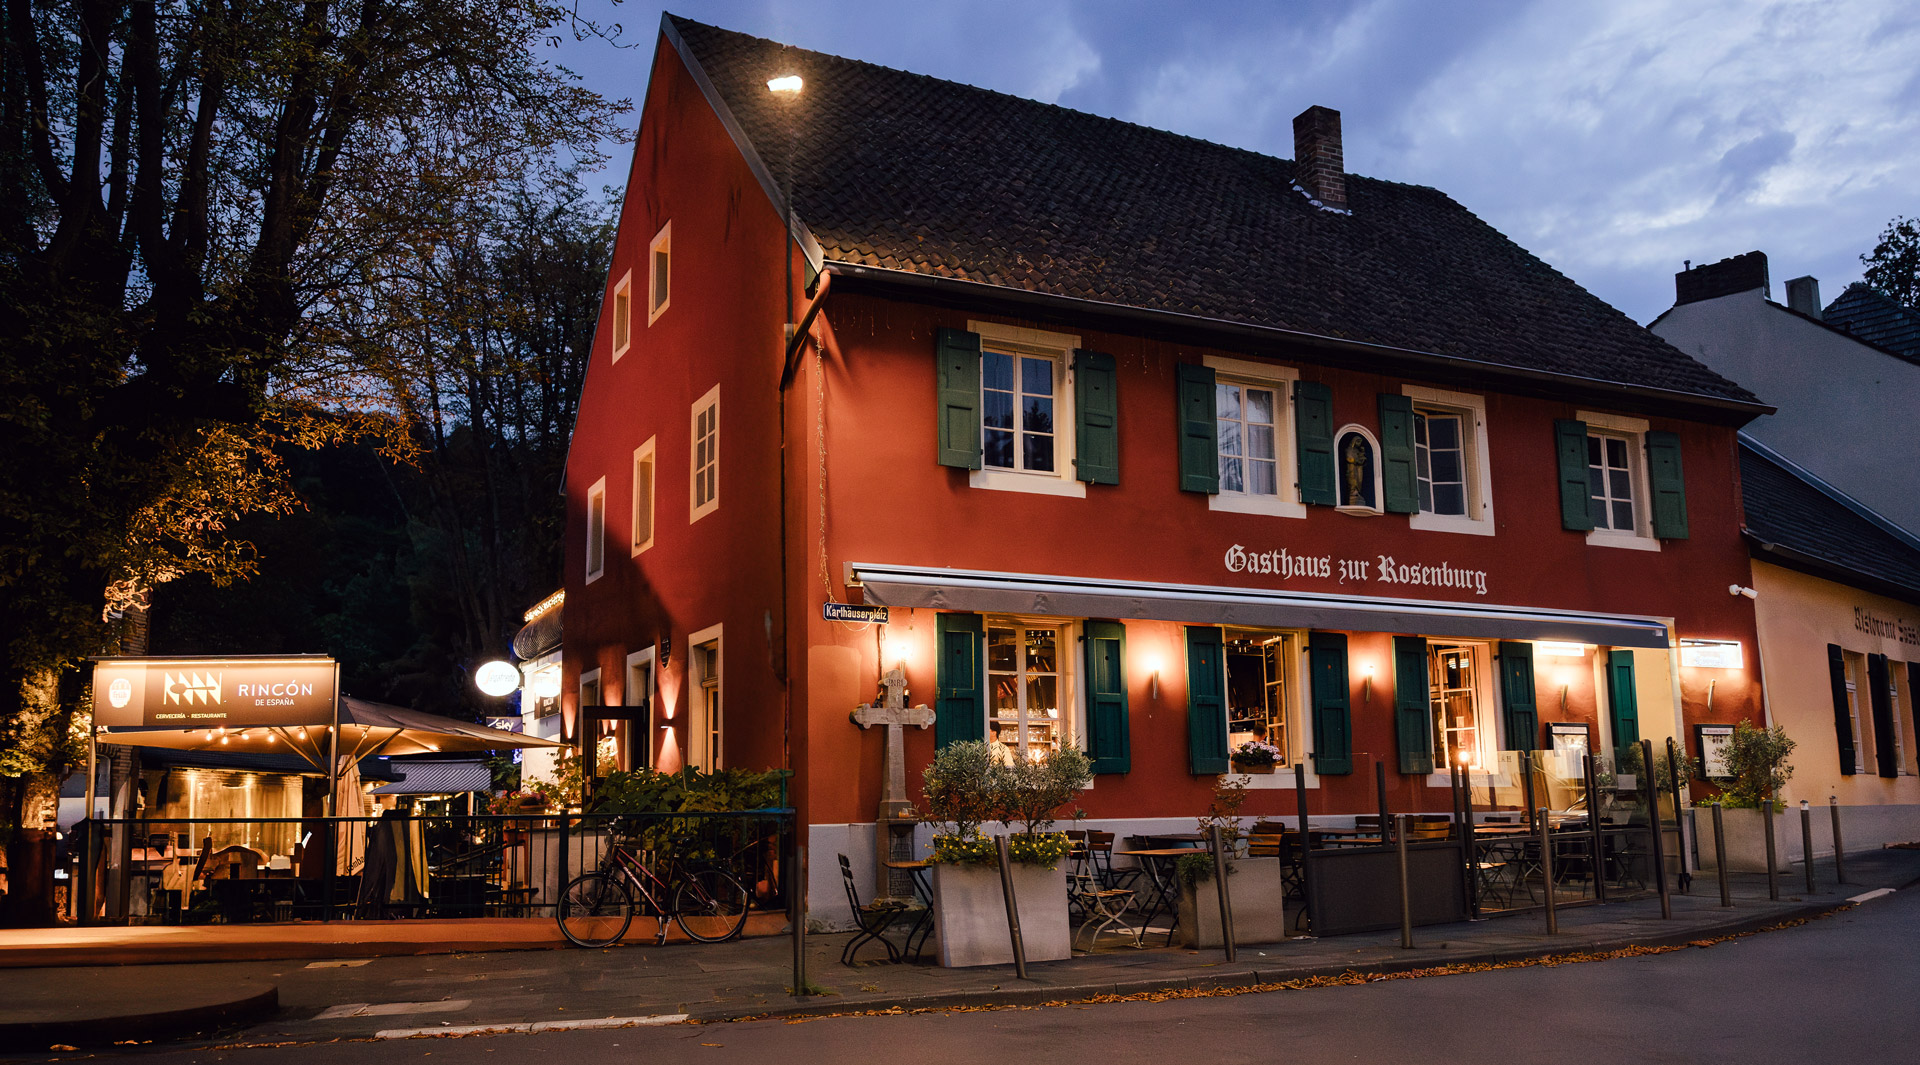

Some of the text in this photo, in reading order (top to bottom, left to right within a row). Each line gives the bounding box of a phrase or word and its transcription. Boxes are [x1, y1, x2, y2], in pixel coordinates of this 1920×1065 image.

[1224, 543, 1488, 596] Gasthaus zur Rosenburg
[826, 604, 887, 622] Karthäuserplatz
[238, 679, 313, 697] RINCÓN
[266, 697, 295, 706] ESPAÑA
[495, 719, 514, 732] sky
